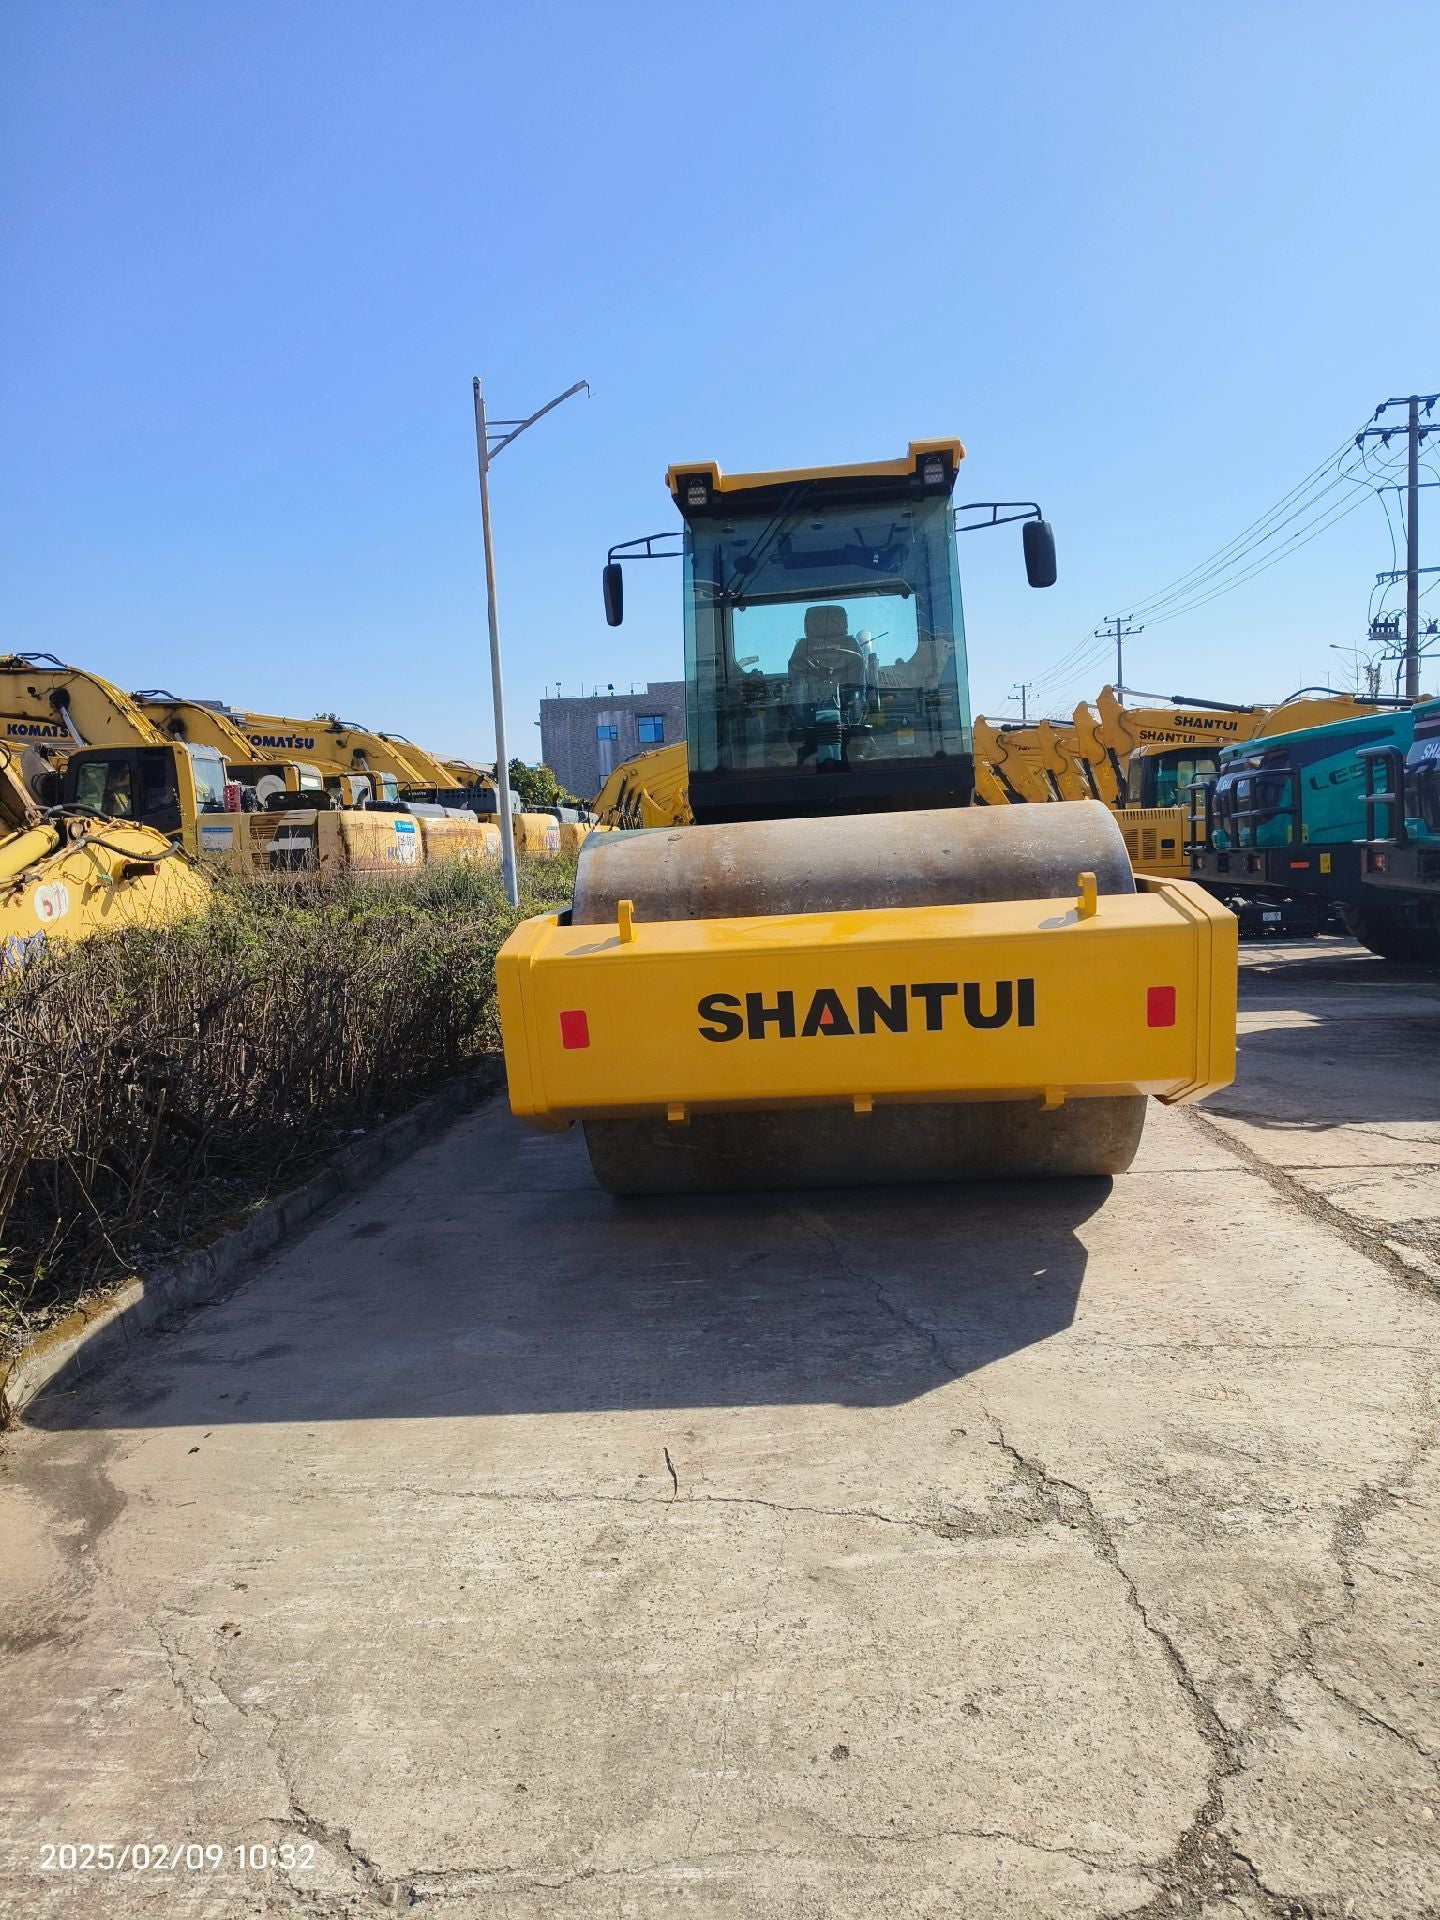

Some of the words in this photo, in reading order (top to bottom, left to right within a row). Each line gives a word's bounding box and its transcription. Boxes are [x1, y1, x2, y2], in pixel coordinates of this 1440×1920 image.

[7, 724, 74, 737] KOMATS
[1174, 716, 1238, 731] SHANTUI
[1140, 730, 1196, 743] SHANTUI
[698, 978, 1035, 1043] SHANTUI
